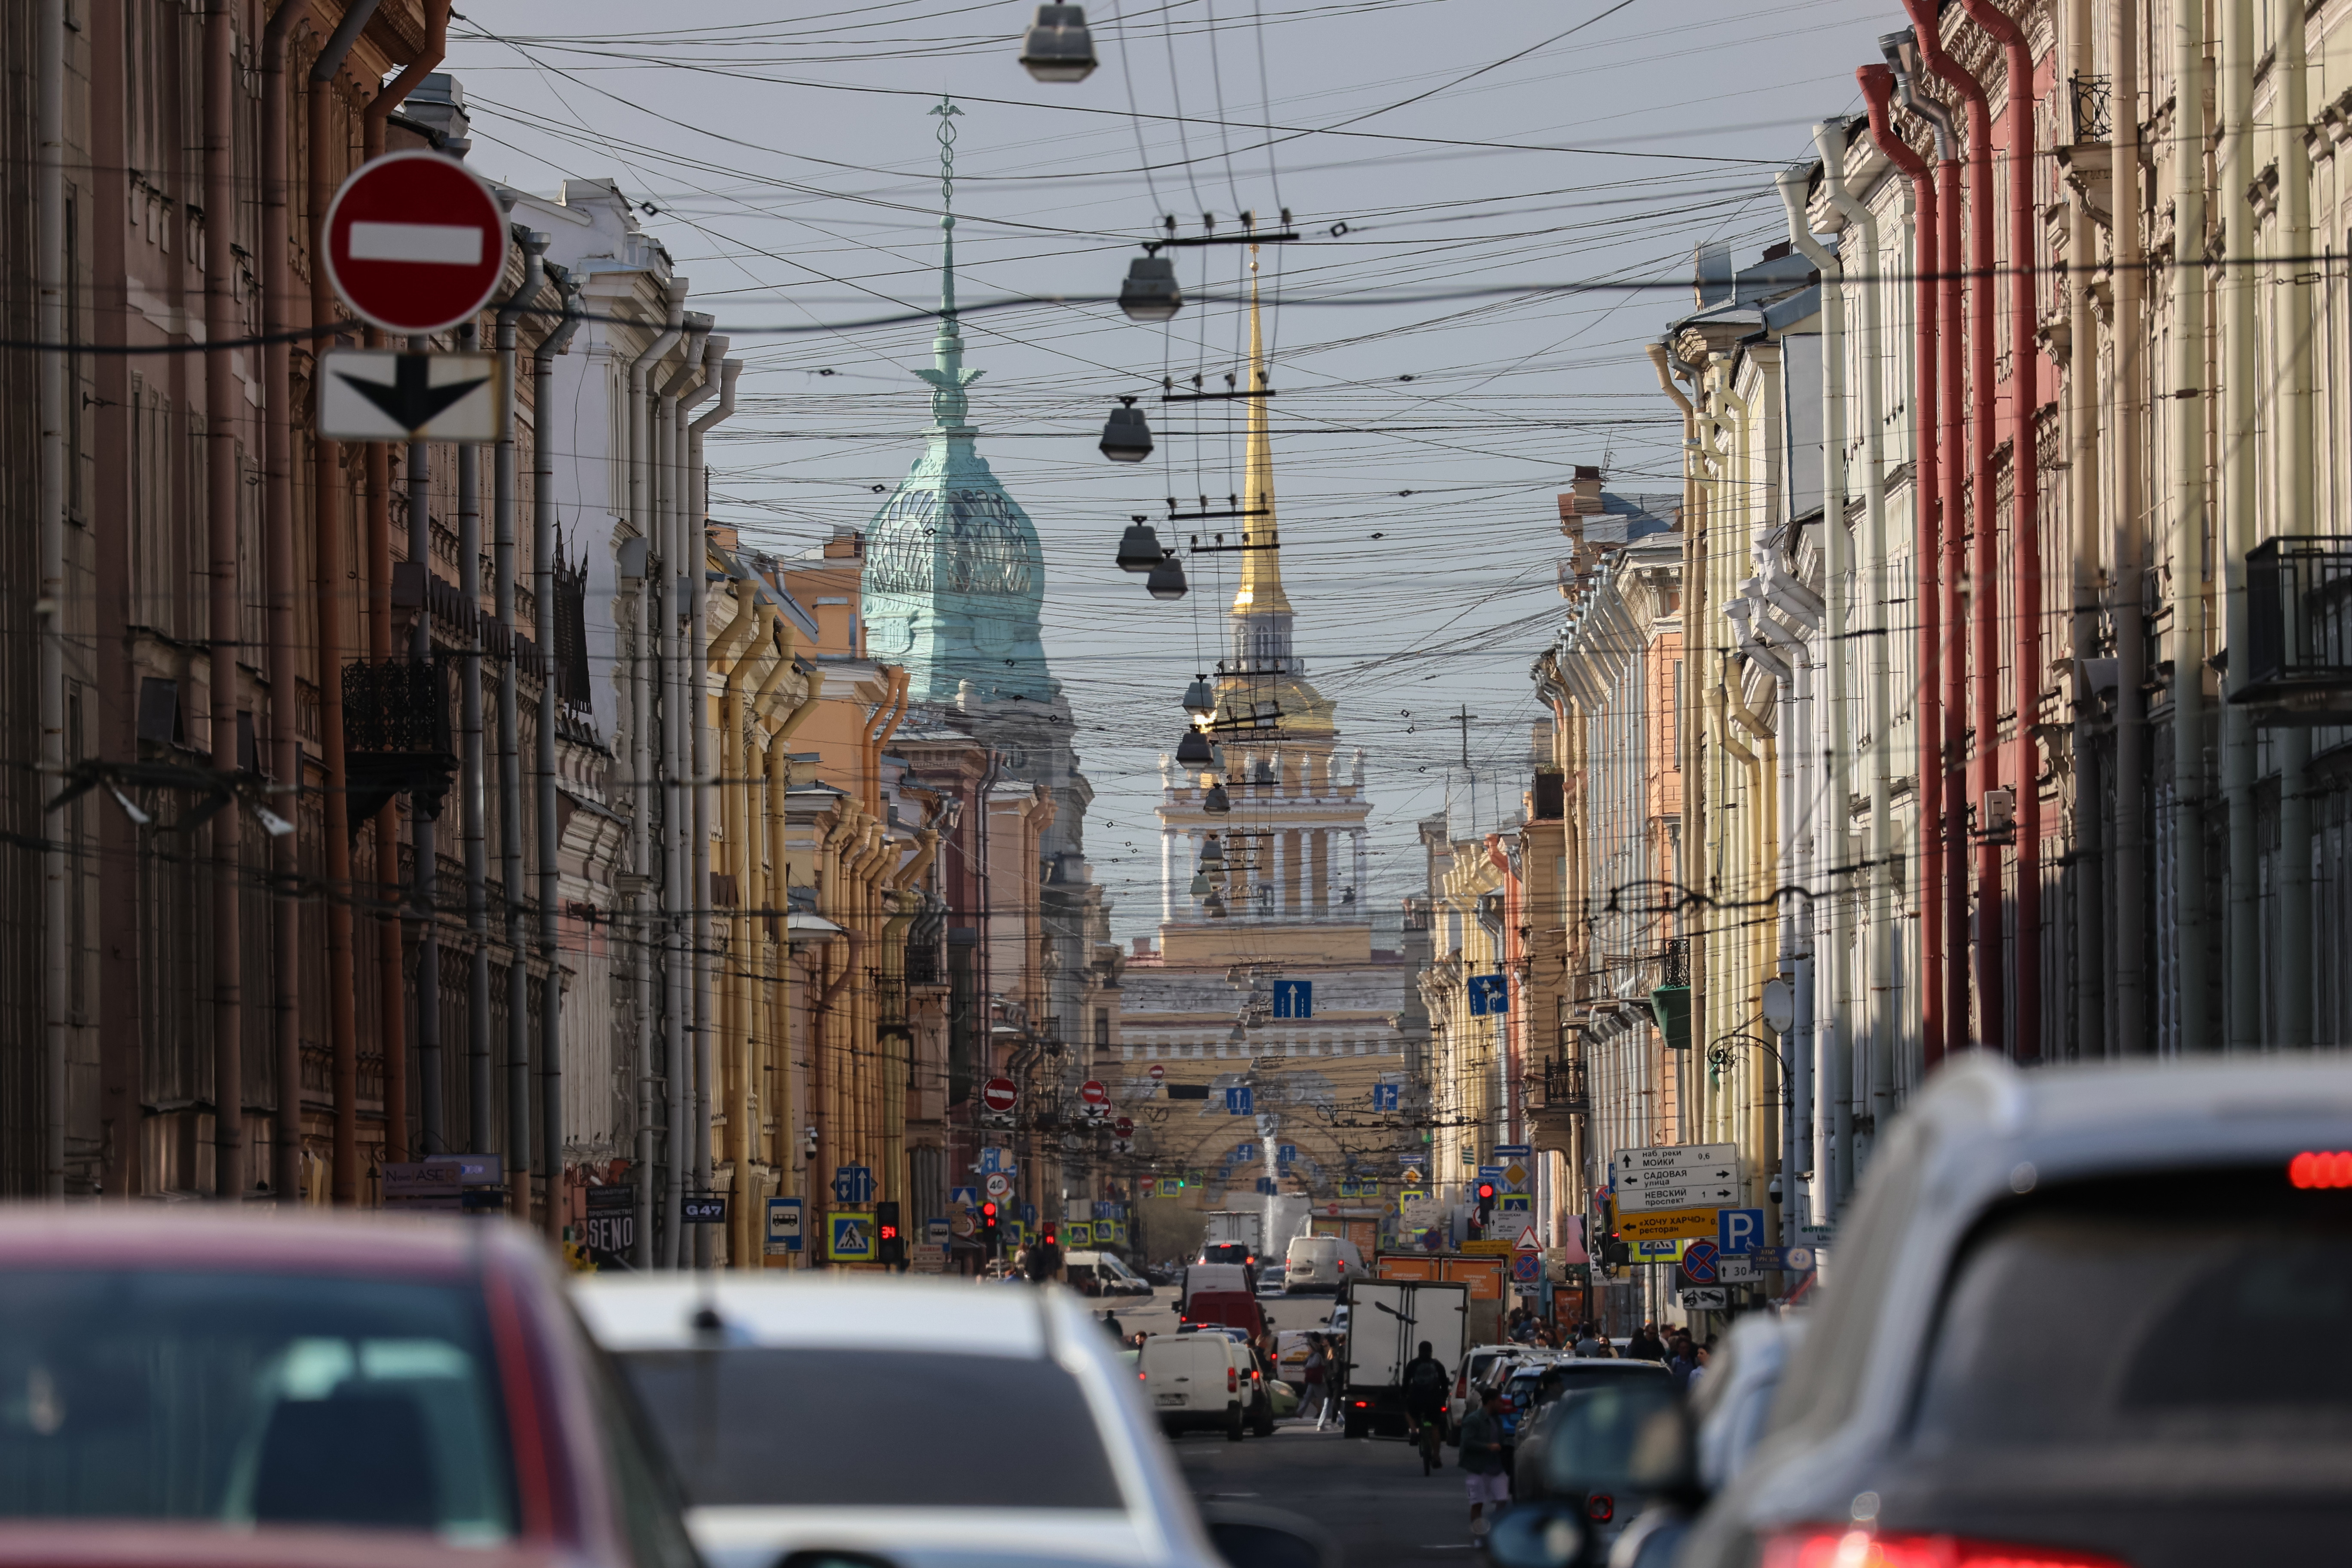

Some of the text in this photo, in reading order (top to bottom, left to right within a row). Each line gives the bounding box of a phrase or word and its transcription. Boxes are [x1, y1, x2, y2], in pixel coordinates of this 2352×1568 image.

[1643, 1158, 1674, 1167] МОЙКИ
[1644, 1170, 1687, 1180] САДОВАЯ
[989, 1180, 1004, 1189] 40
[1644, 1179, 1670, 1188] улица
[1645, 1188, 1687, 1198] НЕВСКИЙ
[1645, 1197, 1684, 1207] проспект
[588, 1208, 633, 1217] ПРОСТРАНСТВО
[589, 1217, 633, 1251] SENO
[882, 1226, 896, 1239] 34
[1640, 1226, 1679, 1235] ресторан
[1734, 1267, 1747, 1276] 30
